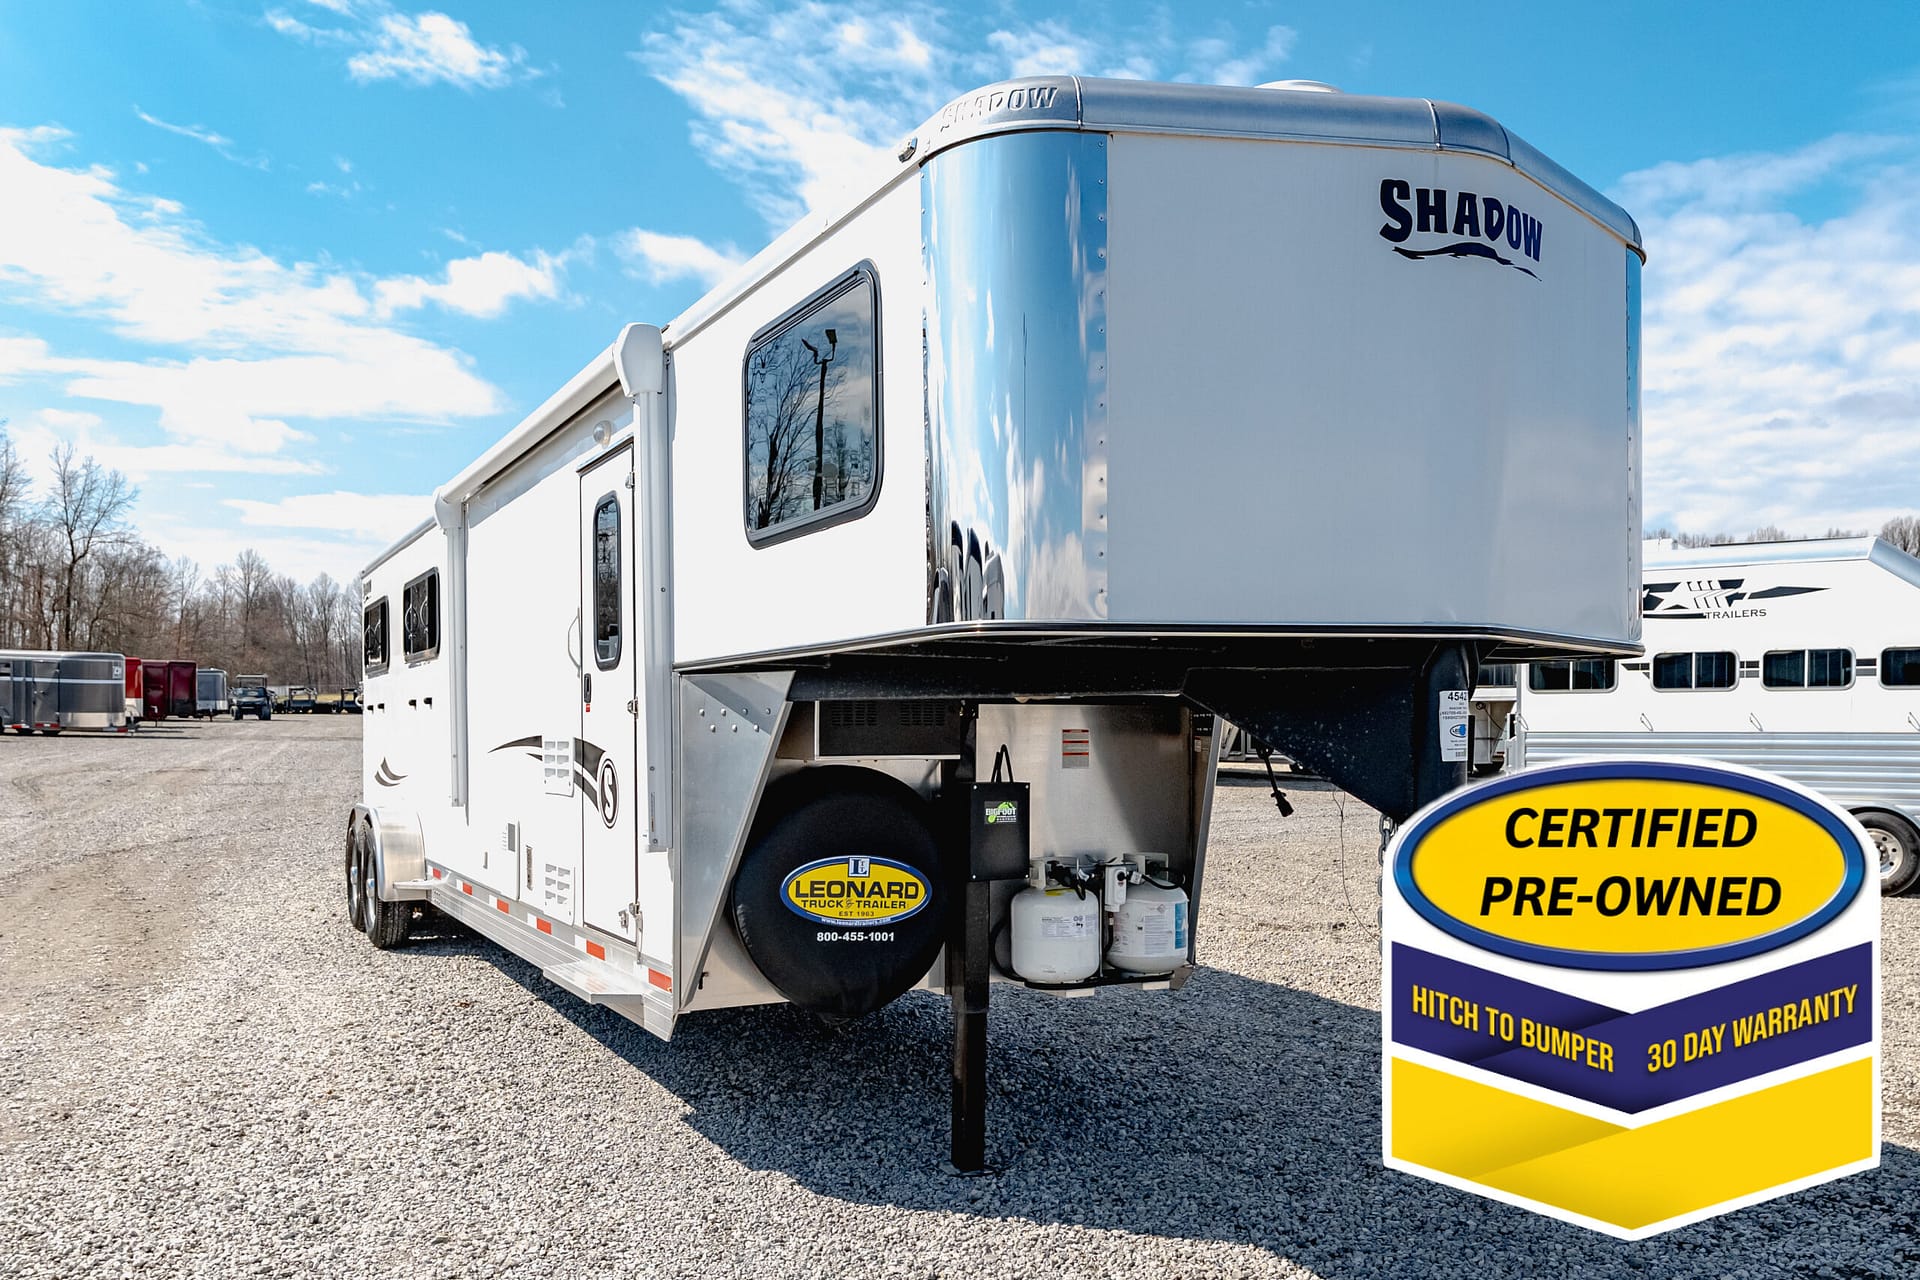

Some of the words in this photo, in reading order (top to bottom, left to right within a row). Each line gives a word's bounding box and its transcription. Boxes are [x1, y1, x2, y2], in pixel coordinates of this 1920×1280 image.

[940, 86, 1058, 132] SHADOW
[1379, 179, 1543, 263] SHADOW
[1705, 608, 1767, 620] TRAILERS
[985, 808, 1017, 816] BIGFOOT
[795, 880, 919, 899] LEONARD
[801, 900, 844, 908] TRUCK
[855, 900, 907, 909] TRAILER
[816, 931, 895, 942] 800-455-1001
